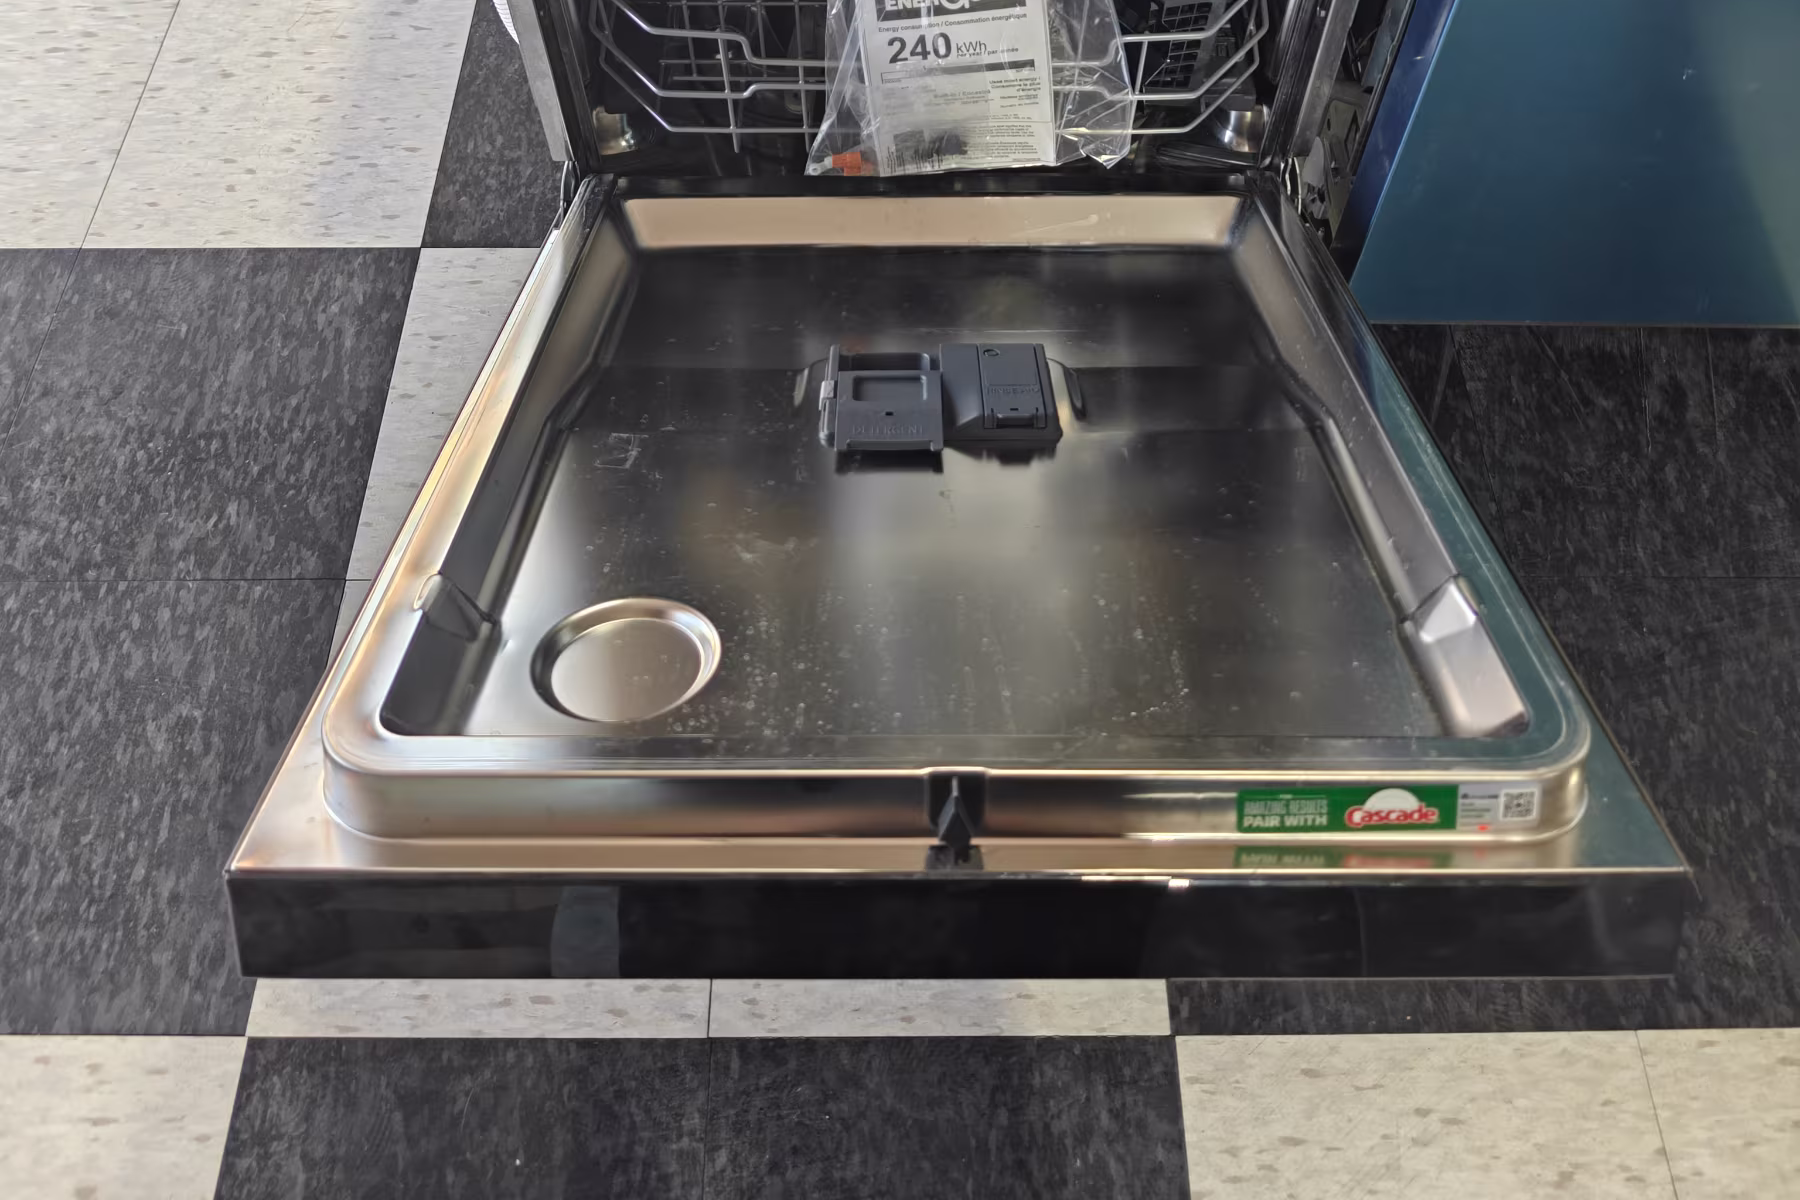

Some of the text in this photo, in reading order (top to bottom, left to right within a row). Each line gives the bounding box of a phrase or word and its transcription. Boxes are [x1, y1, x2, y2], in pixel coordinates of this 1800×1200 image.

[878, 26, 900, 35] Energy
[900, 22, 941, 32] consumtion
[944, 17, 991, 29] Consommation
[887, 32, 987, 65] 240 kWh
[852, 424, 923, 434] DETERGENT
[1243, 798, 1328, 816] AMAZING RESULTS
[1345, 803, 1440, 829] Cascade
[1243, 813, 1328, 828] PAIR WITH
